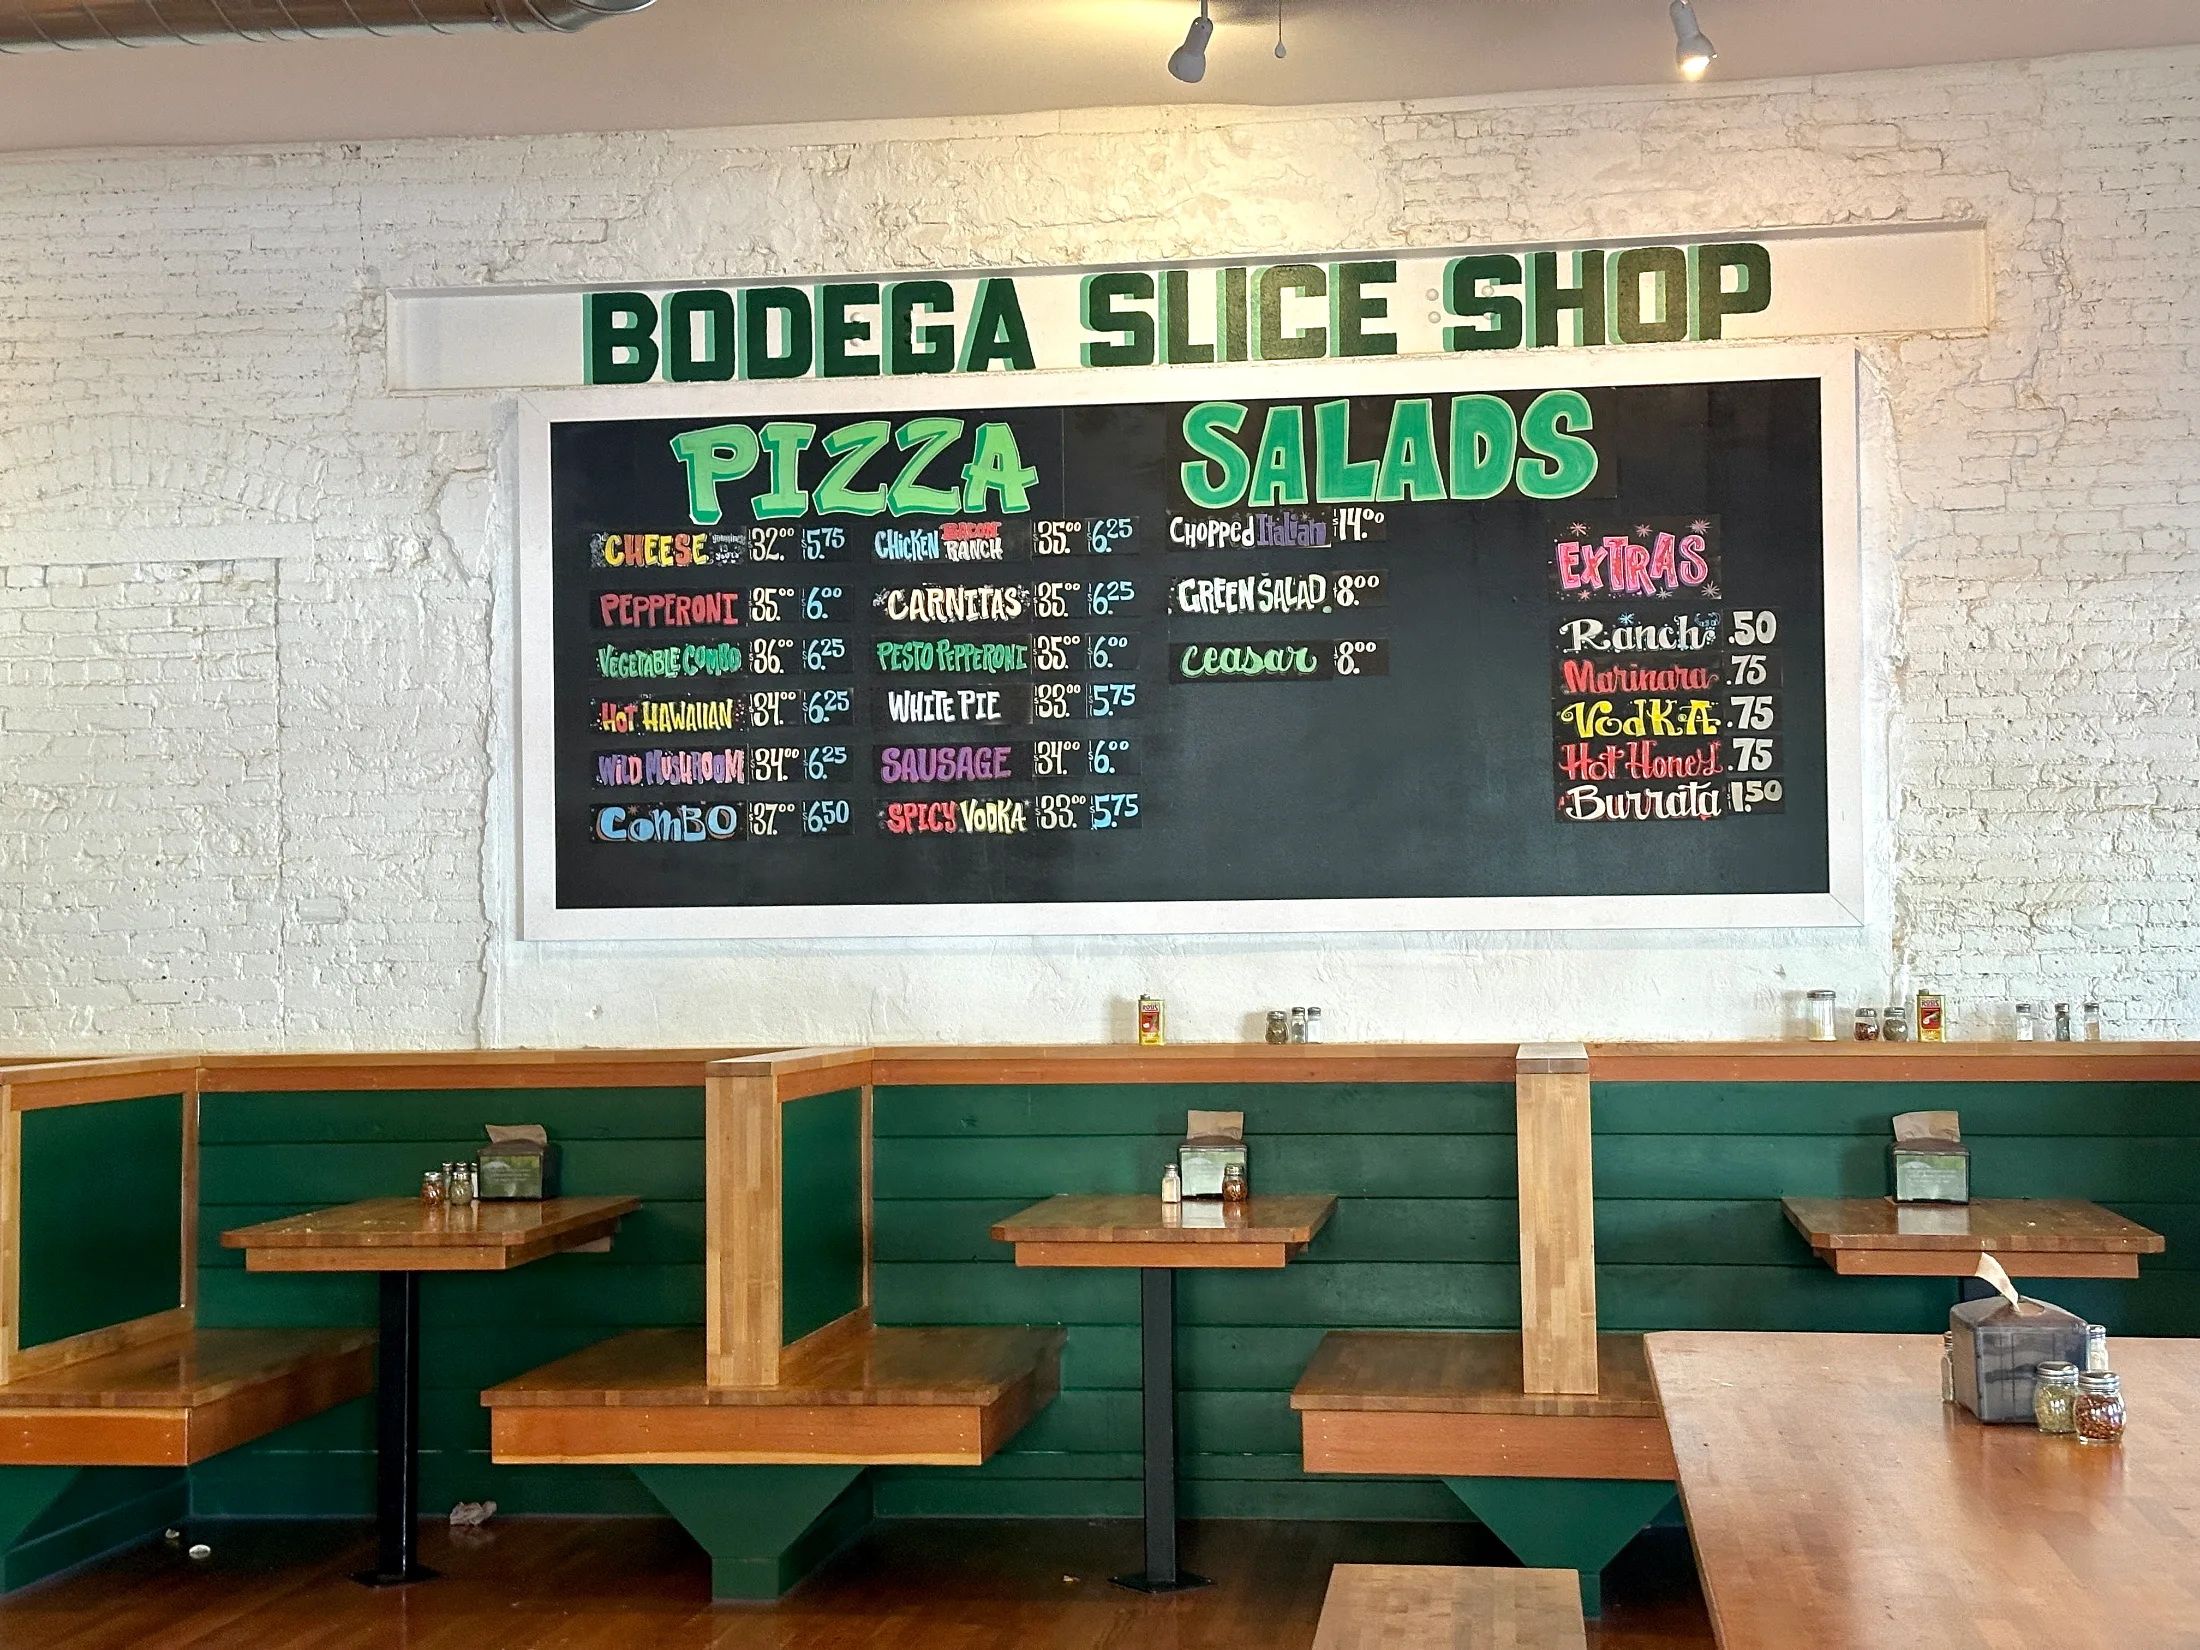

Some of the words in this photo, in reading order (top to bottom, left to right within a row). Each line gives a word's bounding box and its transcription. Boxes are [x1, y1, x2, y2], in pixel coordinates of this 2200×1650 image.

[583, 278, 1037, 385] BODEGA
[1079, 260, 1398, 367] SLICE
[1443, 242, 1772, 352] SHOP
[1180, 389, 1599, 509] SALADS
[671, 417, 1038, 525] PIZZA
[939, 521, 1002, 540] BACON
[1255, 512, 1327, 546] Italian
[604, 532, 709, 567] CHEESE
[943, 537, 1003, 562] RANCH
[1556, 532, 1709, 596] EXTRAS
[600, 592, 738, 627] PEPPERONI
[886, 587, 1023, 621] CARNITAS
[1177, 577, 1257, 614] GREEN
[1559, 615, 1717, 652] Ranch
[598, 643, 680, 679] VEGETABLE
[682, 642, 742, 676] COMBO
[877, 640, 933, 672] PESTO
[935, 640, 1028, 674] PEPPERONI
[1562, 658, 1719, 694] Marinara
[601, 702, 638, 733] HOT
[642, 698, 734, 732] HAWAIIAN
[888, 689, 955, 723] WHITE
[958, 689, 1001, 721] PIE
[645, 749, 745, 785] MUSHROOM
[881, 745, 1012, 782] SAUSAGE
[1558, 741, 1624, 780] Hot
[887, 801, 958, 834] SPICY
[1565, 781, 1721, 820] Burrata
